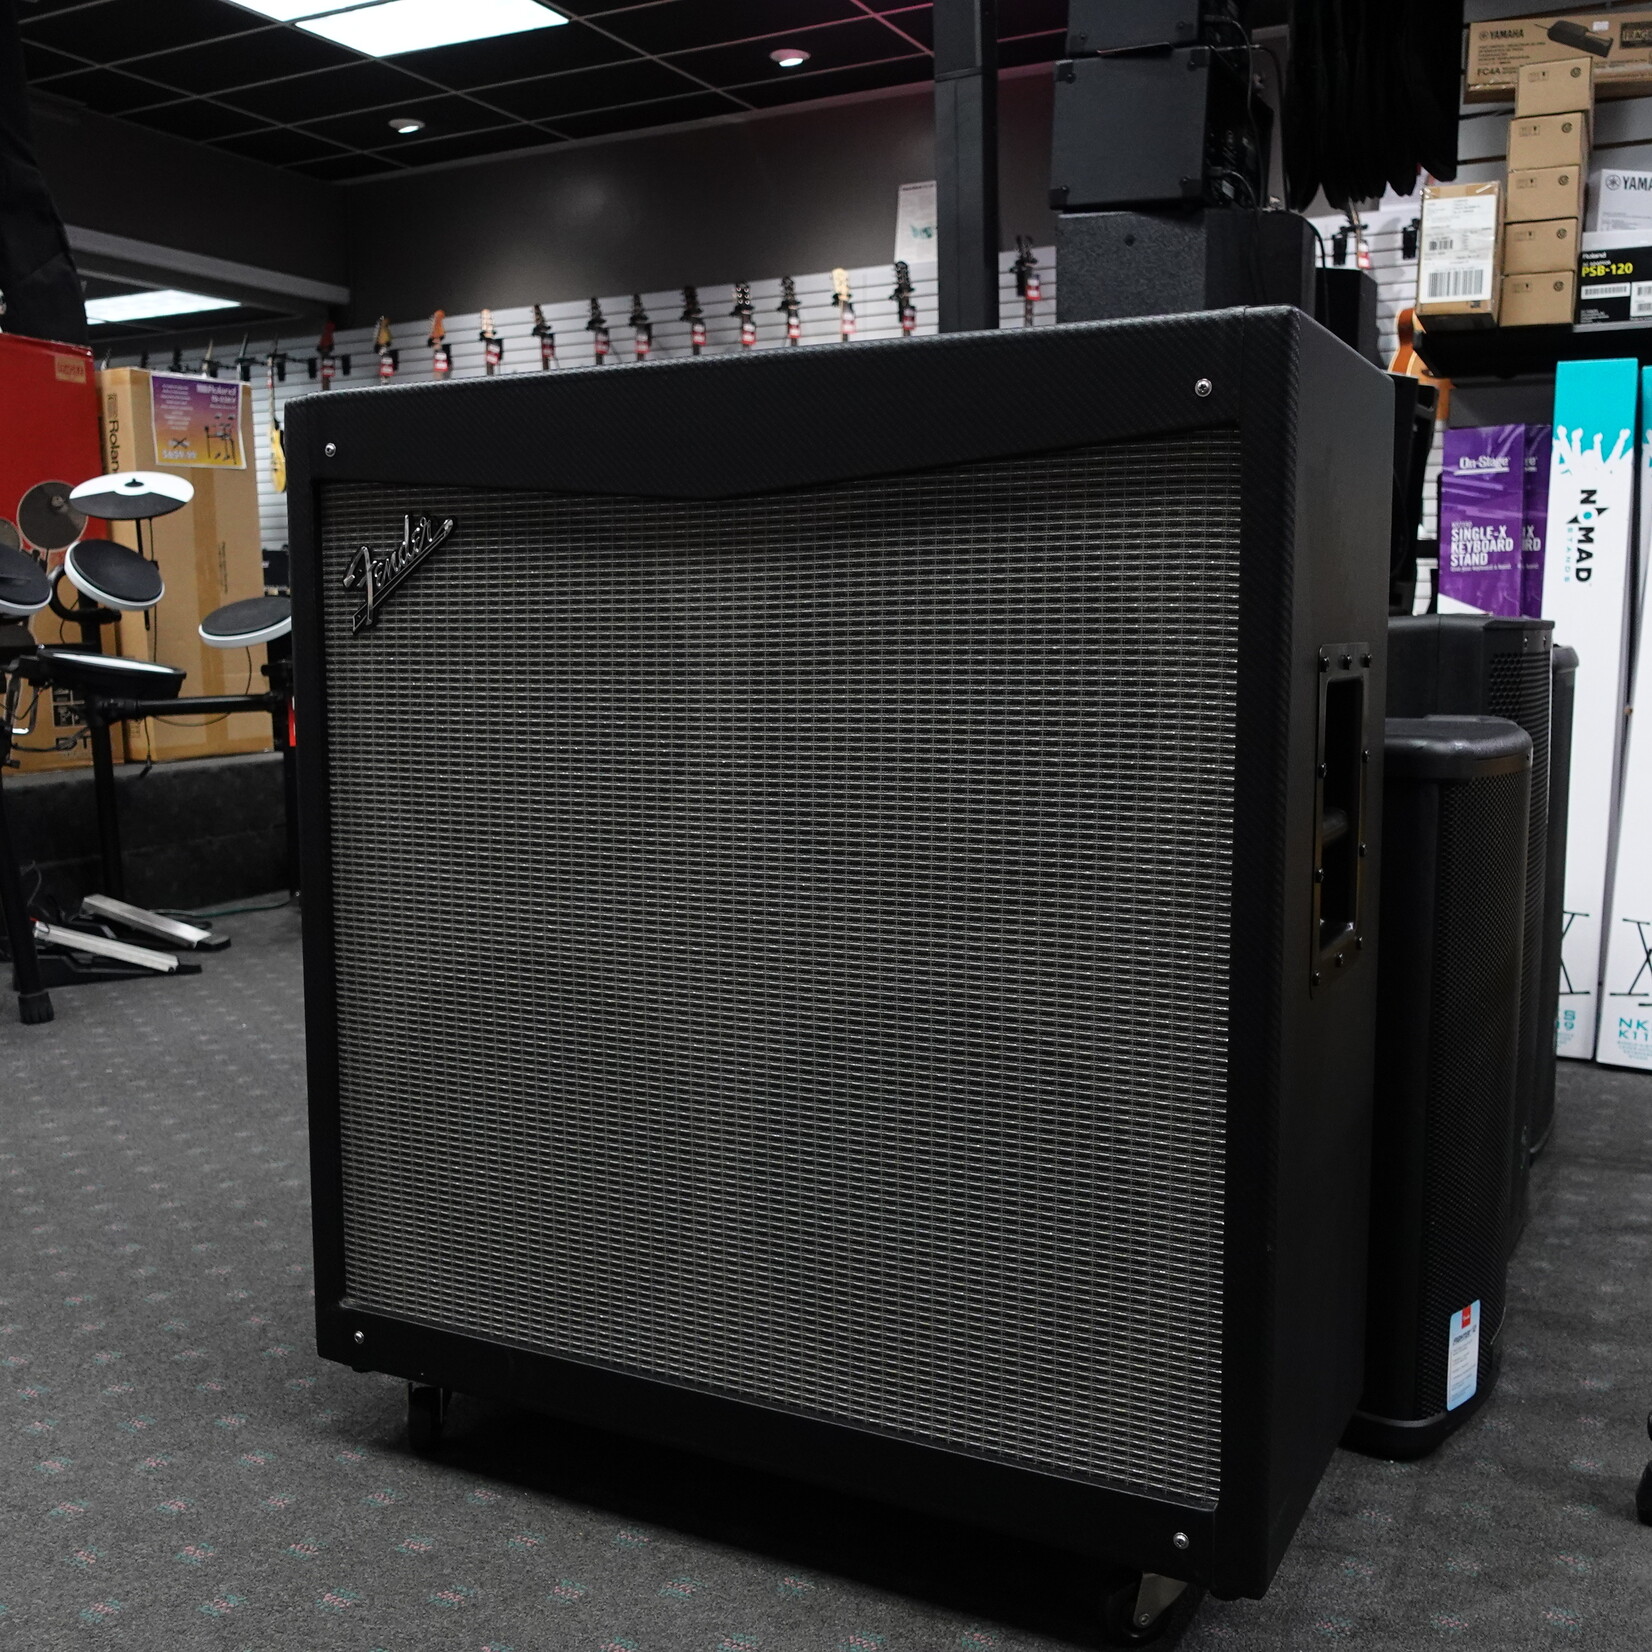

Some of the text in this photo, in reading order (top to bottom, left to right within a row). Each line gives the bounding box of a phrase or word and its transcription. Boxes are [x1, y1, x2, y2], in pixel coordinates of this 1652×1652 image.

[1490, 29, 1524, 40] YAMAHA
[1581, 262, 1634, 278] PSB-120
[106, 420, 121, 474] Rolan
[1459, 455, 1510, 469] On-Stage
[1451, 525, 1507, 541] SINGLE-X
[1451, 537, 1514, 554] KEYBOARD
[1450, 552, 1489, 567] STAND
[343, 514, 446, 630] Fender
[1619, 1017, 1649, 1031] NK
[1619, 1030, 1649, 1042] K11
